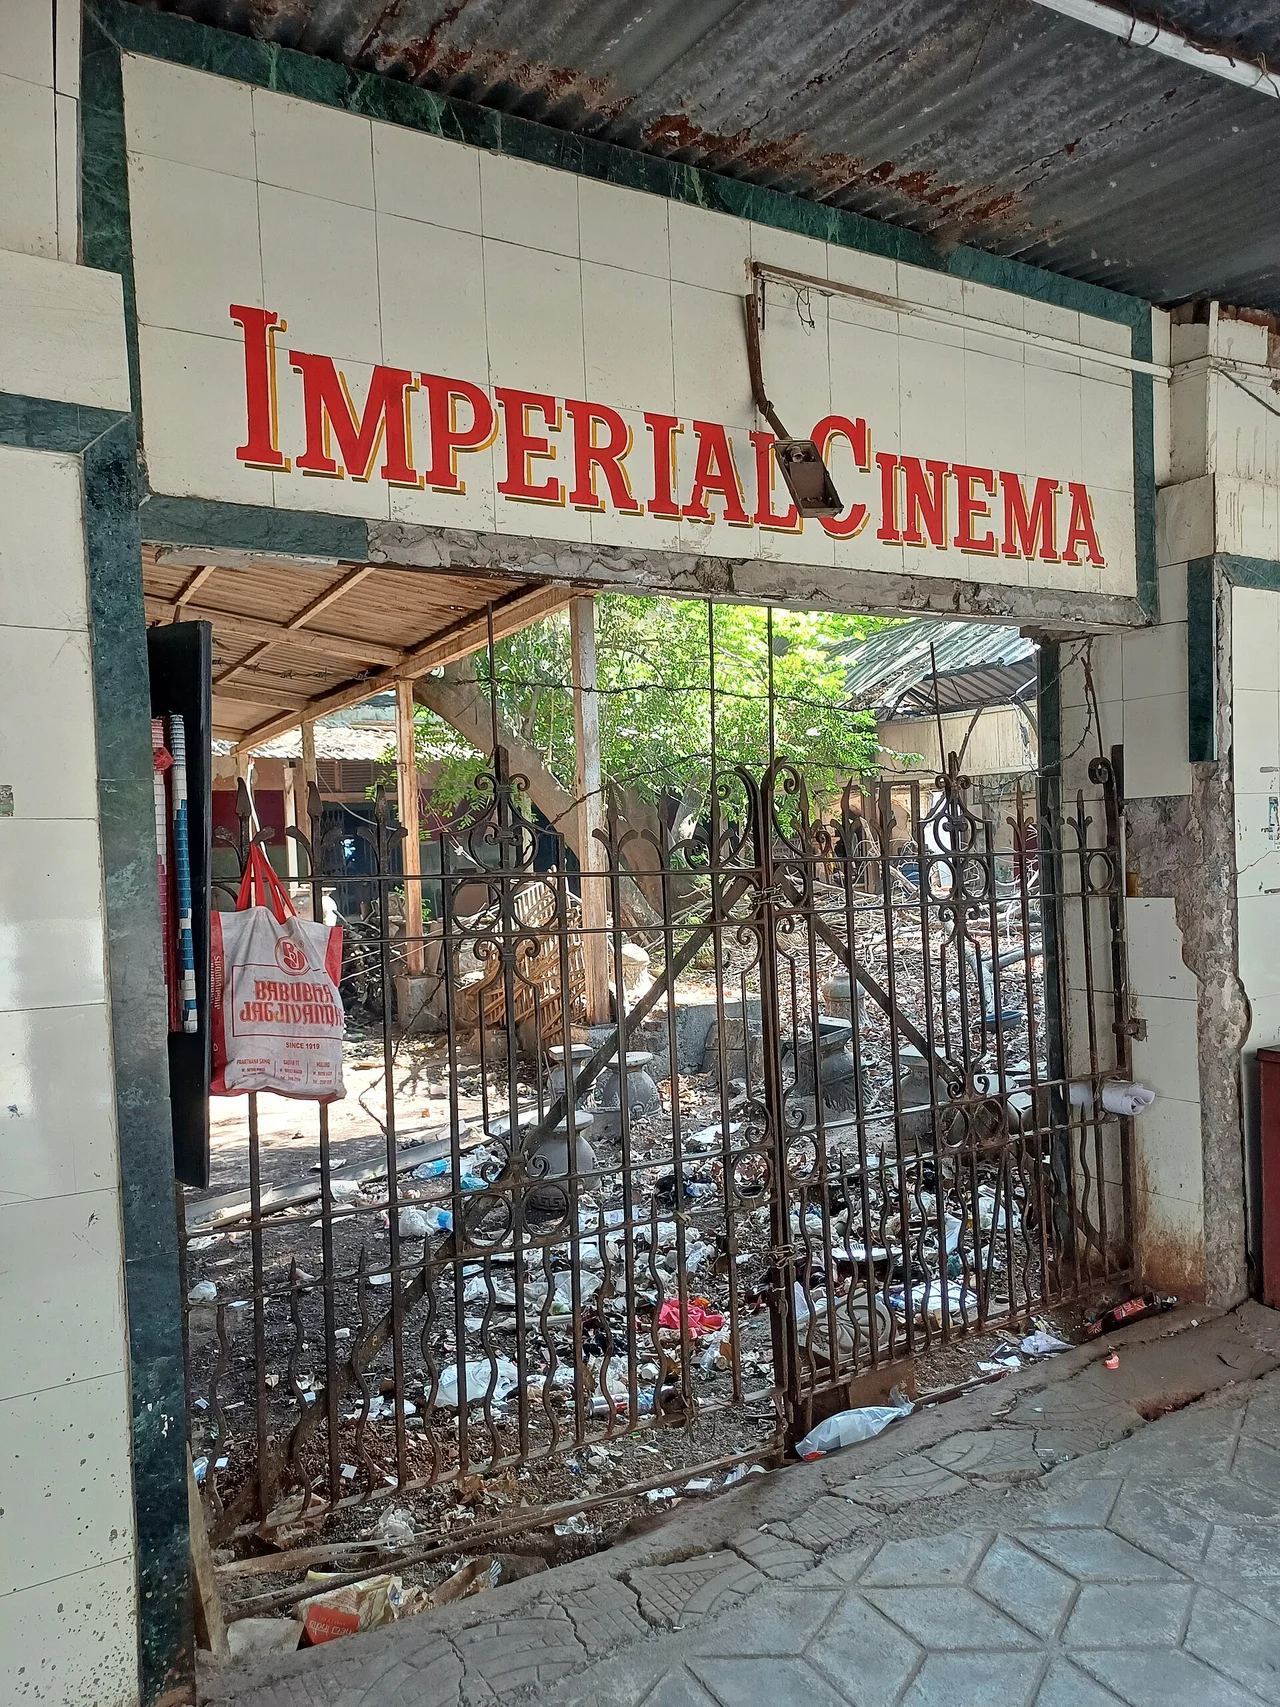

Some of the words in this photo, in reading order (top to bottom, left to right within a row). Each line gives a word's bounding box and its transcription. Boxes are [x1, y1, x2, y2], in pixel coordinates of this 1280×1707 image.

[229, 303, 804, 535] IMPERIAL
[808, 414, 1107, 568] CINEMA
[306, 1042, 320, 1050] 1919
